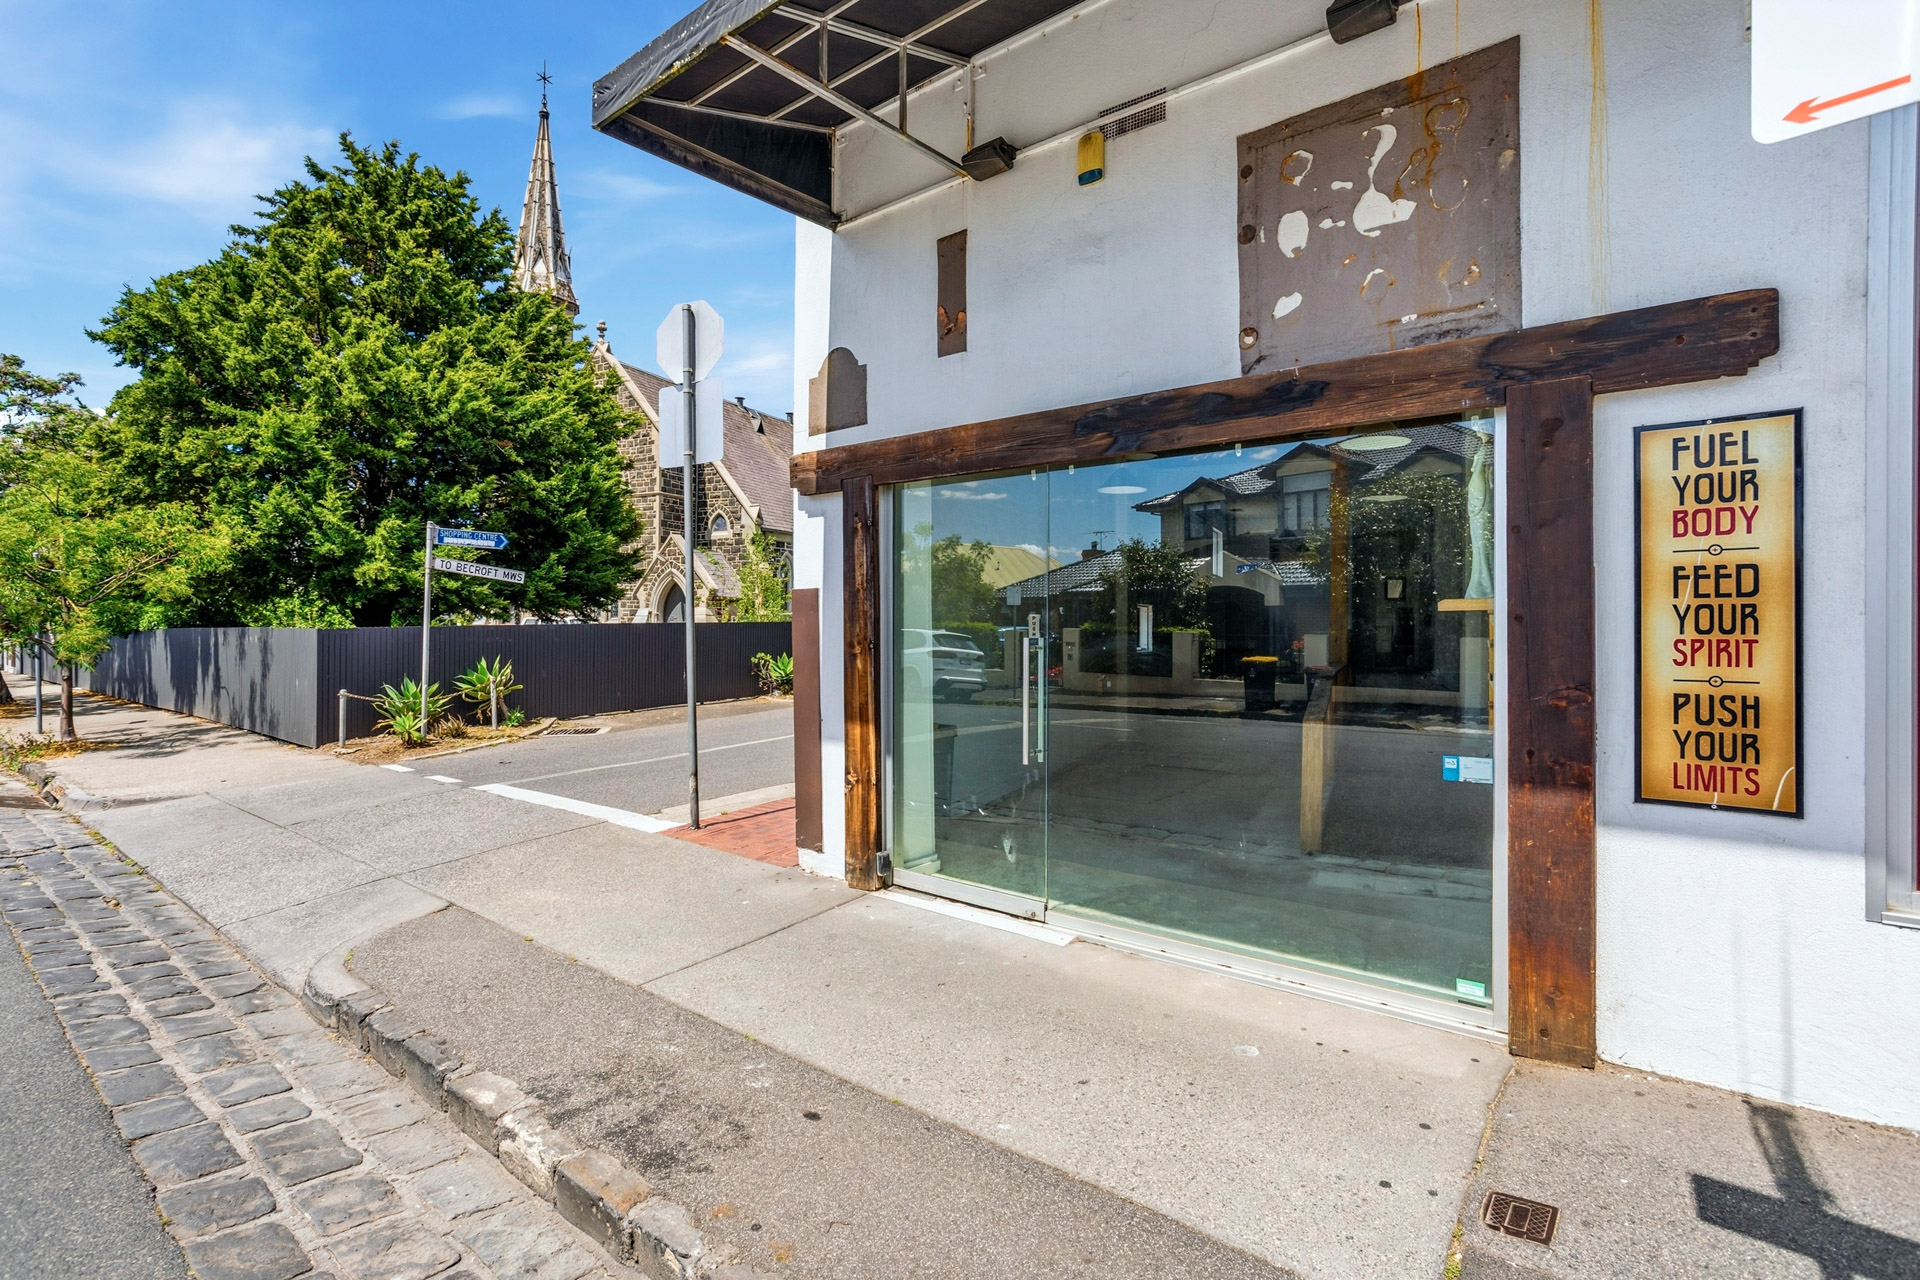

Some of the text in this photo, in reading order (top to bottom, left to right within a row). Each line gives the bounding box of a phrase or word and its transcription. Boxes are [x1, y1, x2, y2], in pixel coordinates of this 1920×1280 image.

[1672, 430, 1759, 471] FUEL
[1672, 469, 1759, 506] YOUR
[440, 529, 498, 541] SHOPPING CENTRE
[1672, 505, 1759, 538] BODY
[440, 560, 523, 582] TO BECROFT MWS
[1672, 563, 1760, 599] FEED
[1672, 603, 1759, 635] YOUR
[1672, 638, 1759, 668] SPIRIT
[1673, 692, 1760, 729] PUSH
[1672, 729, 1760, 765] YOUR
[1672, 761, 1760, 796] LIMITS
